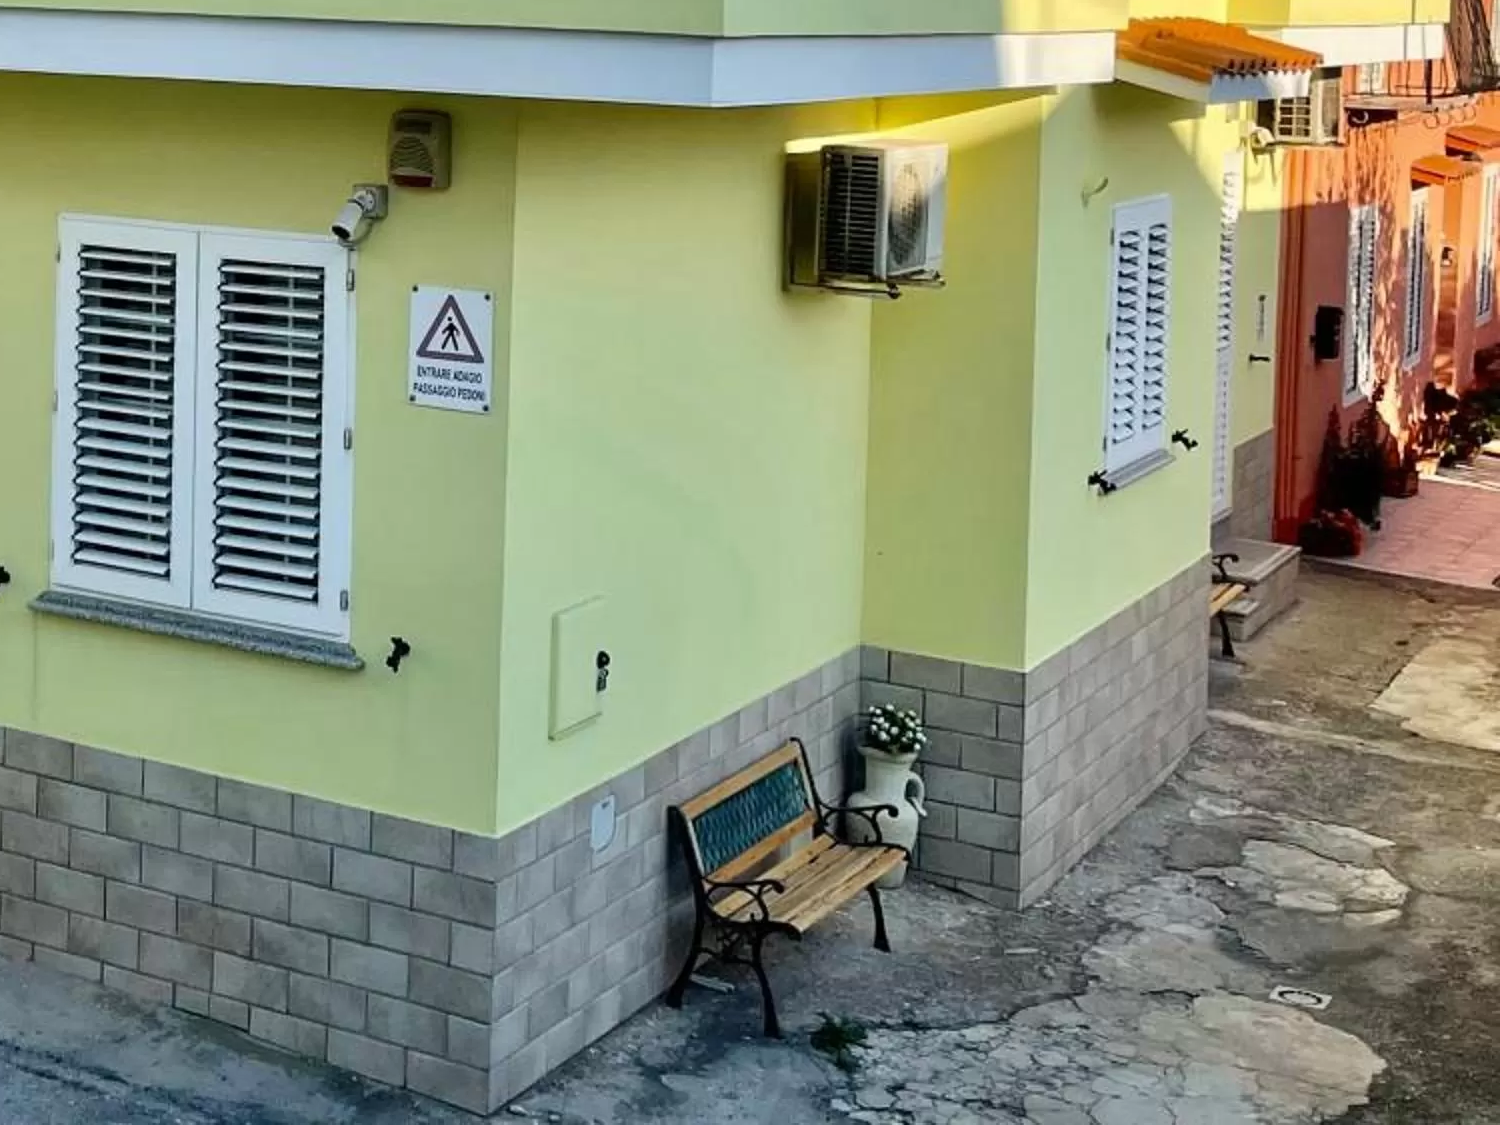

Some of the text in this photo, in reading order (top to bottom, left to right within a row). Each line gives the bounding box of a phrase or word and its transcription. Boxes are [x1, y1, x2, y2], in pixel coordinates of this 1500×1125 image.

[417, 365, 482, 383] ENTRARE ADAGIO
[413, 382, 485, 400] PASSAGGIO PEDONI
